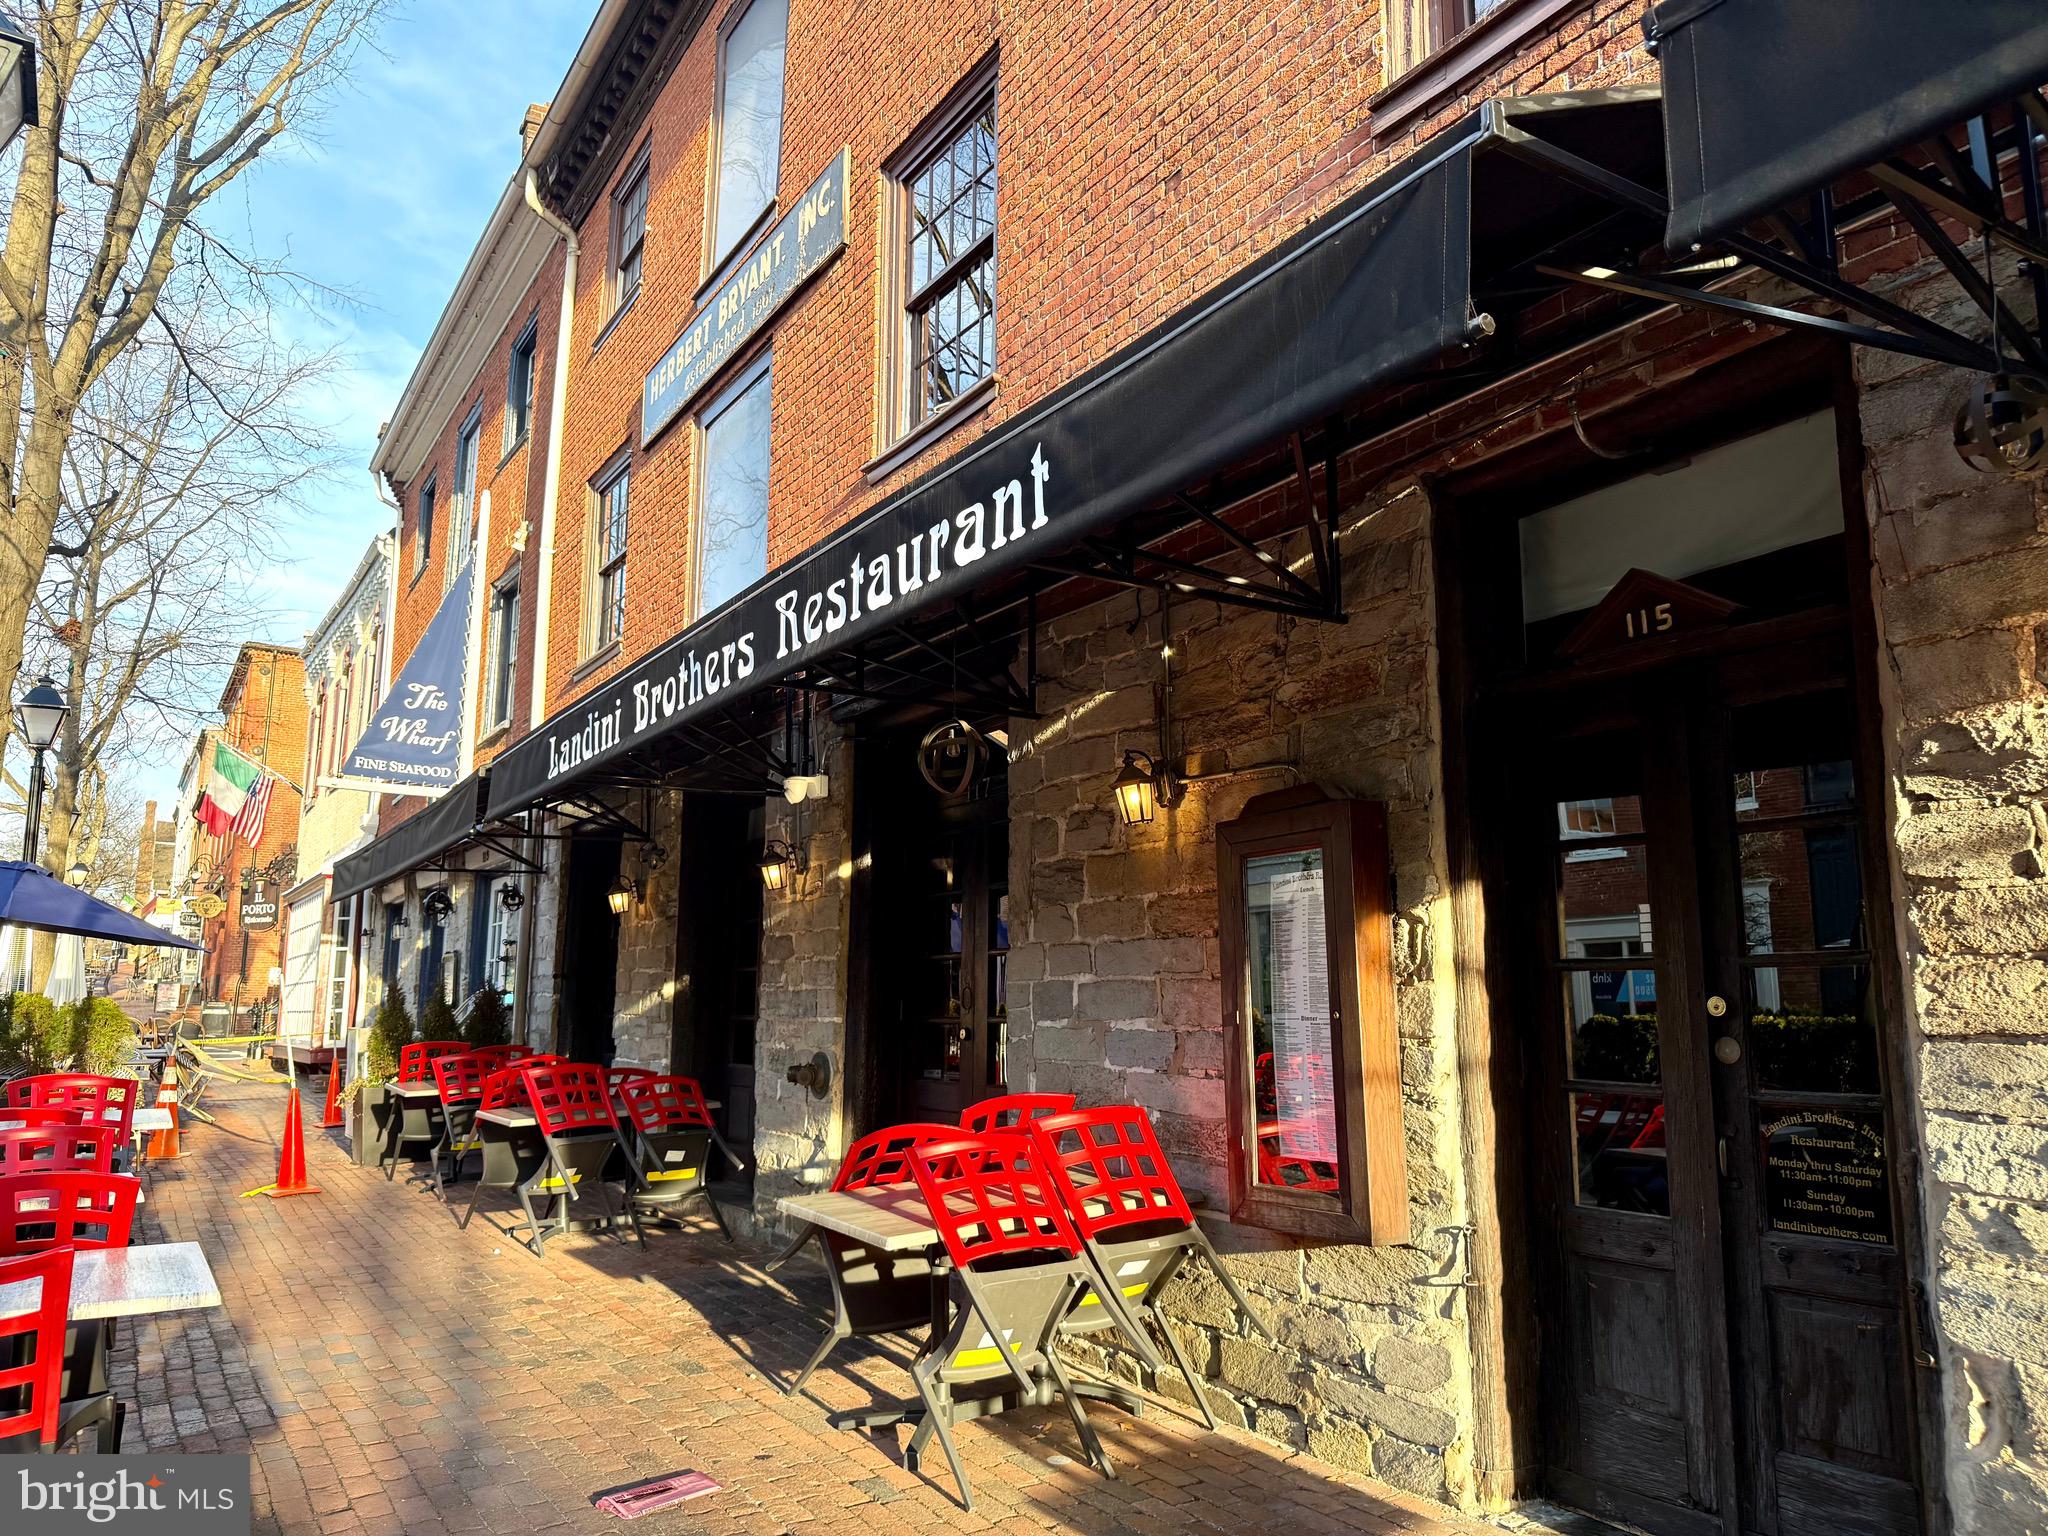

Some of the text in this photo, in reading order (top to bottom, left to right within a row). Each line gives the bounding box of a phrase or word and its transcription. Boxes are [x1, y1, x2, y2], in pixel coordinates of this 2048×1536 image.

[651, 313, 713, 405] HERBERT
[798, 178, 836, 243] INC.
[684, 308, 745, 392] established
[547, 442, 1050, 780] Landini Brothers Restaurant
[1626, 602, 1673, 639] 115
[404, 682, 449, 711] The
[381, 716, 456, 755] Wharf
[354, 756, 452, 778] FINE SEAFOOD
[242, 903, 275, 914] PORTO
[254, 893, 265, 903] IL
[1790, 1134, 1856, 1150] Restaurant
[1769, 1156, 1882, 1178] Monday thru Saturday
[1806, 1189, 1846, 1205] Sunday
[1773, 1218, 1888, 1244] landinibrothers.com
